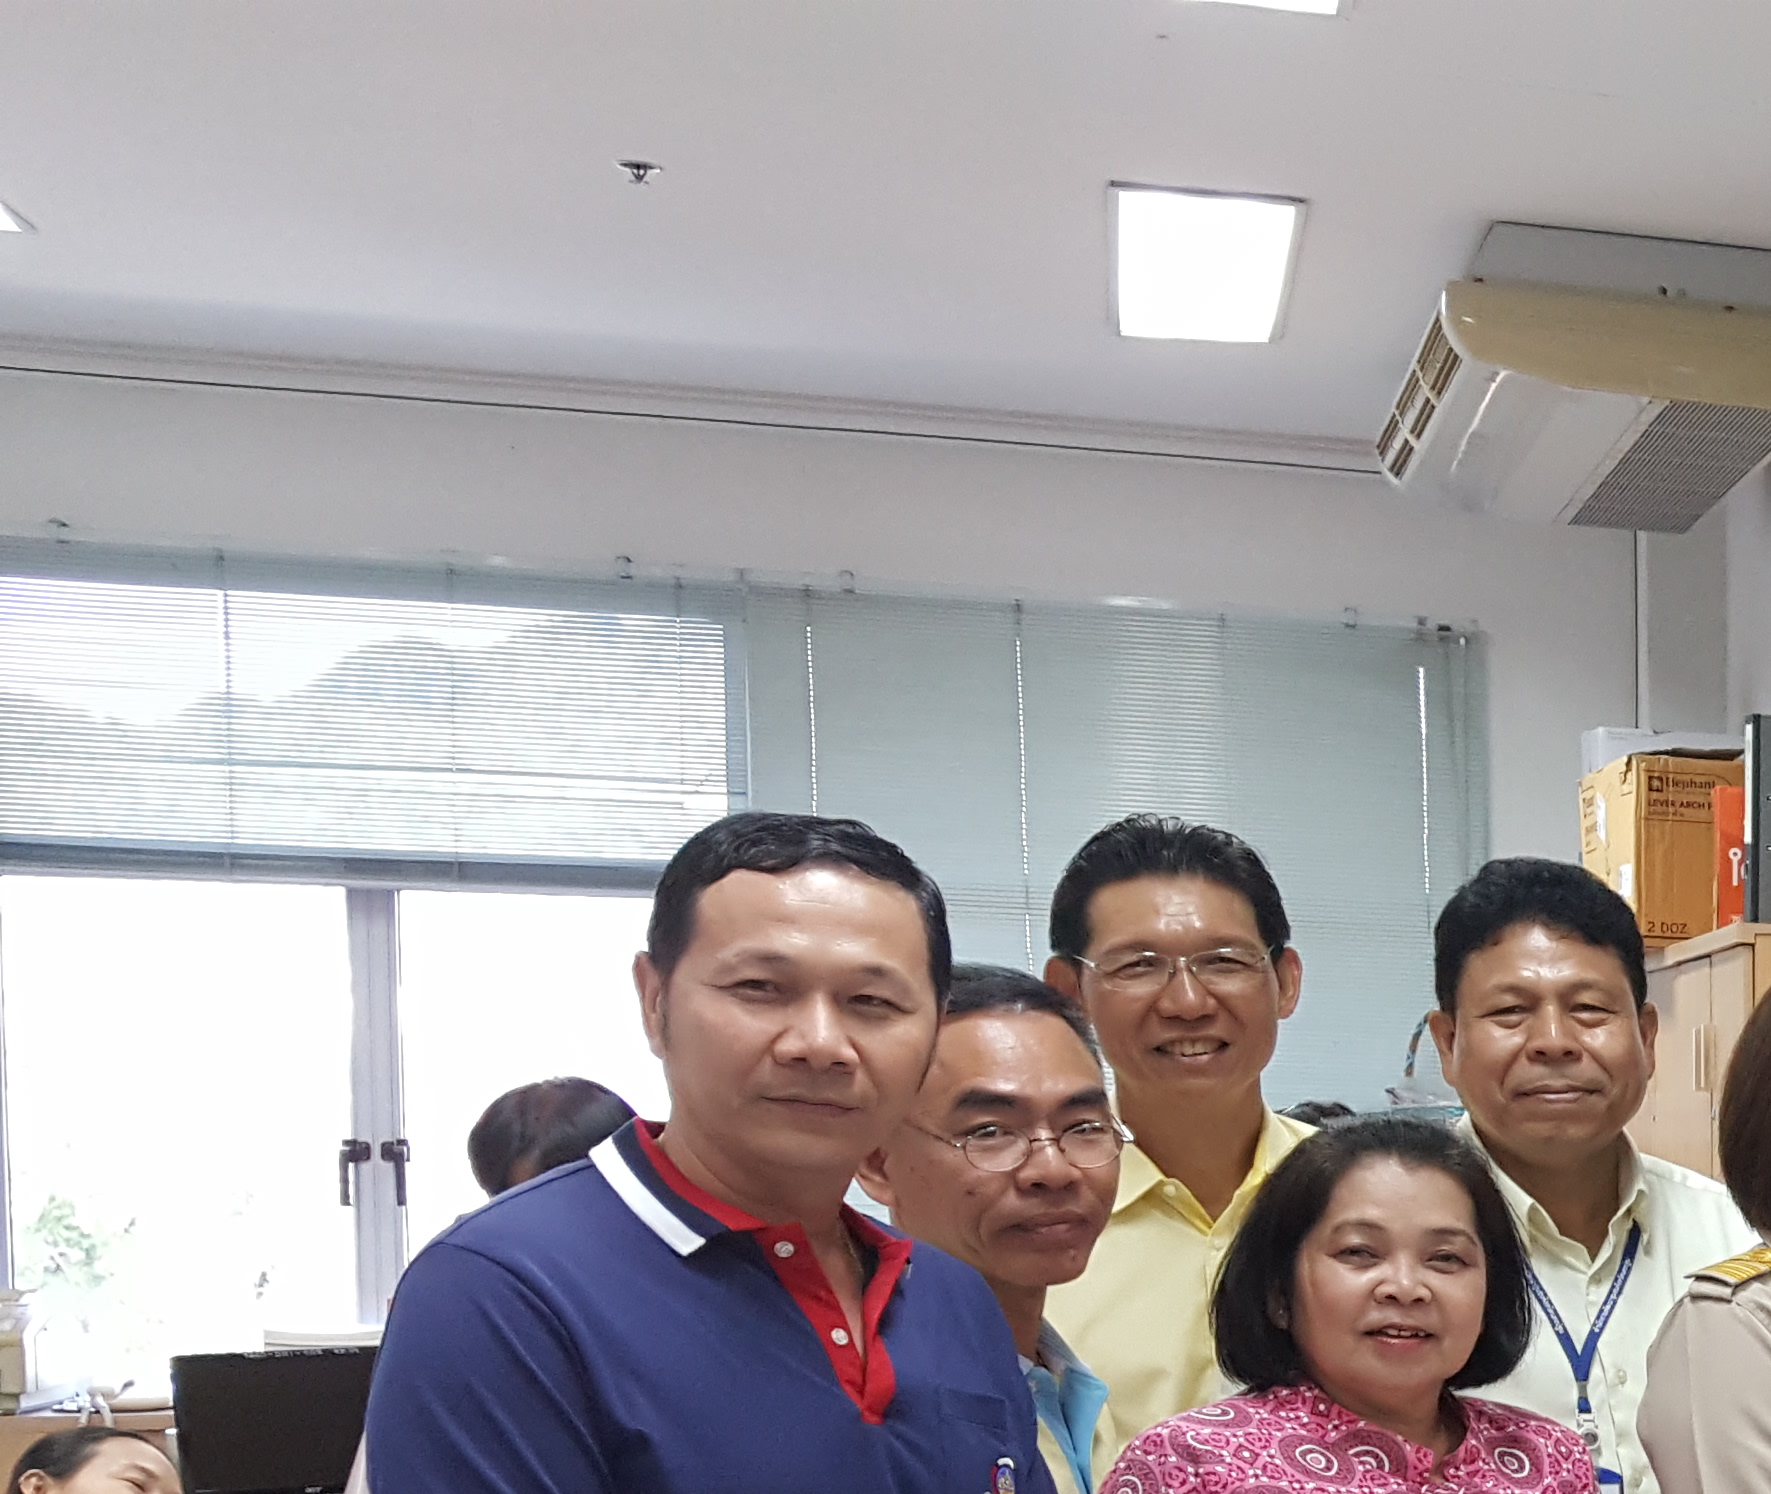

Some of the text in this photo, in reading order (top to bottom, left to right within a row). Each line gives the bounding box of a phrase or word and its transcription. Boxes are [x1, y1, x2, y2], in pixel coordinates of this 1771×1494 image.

[1679, 800, 1705, 810] ARCH
[1647, 921, 1689, 935] 2 DOZ
